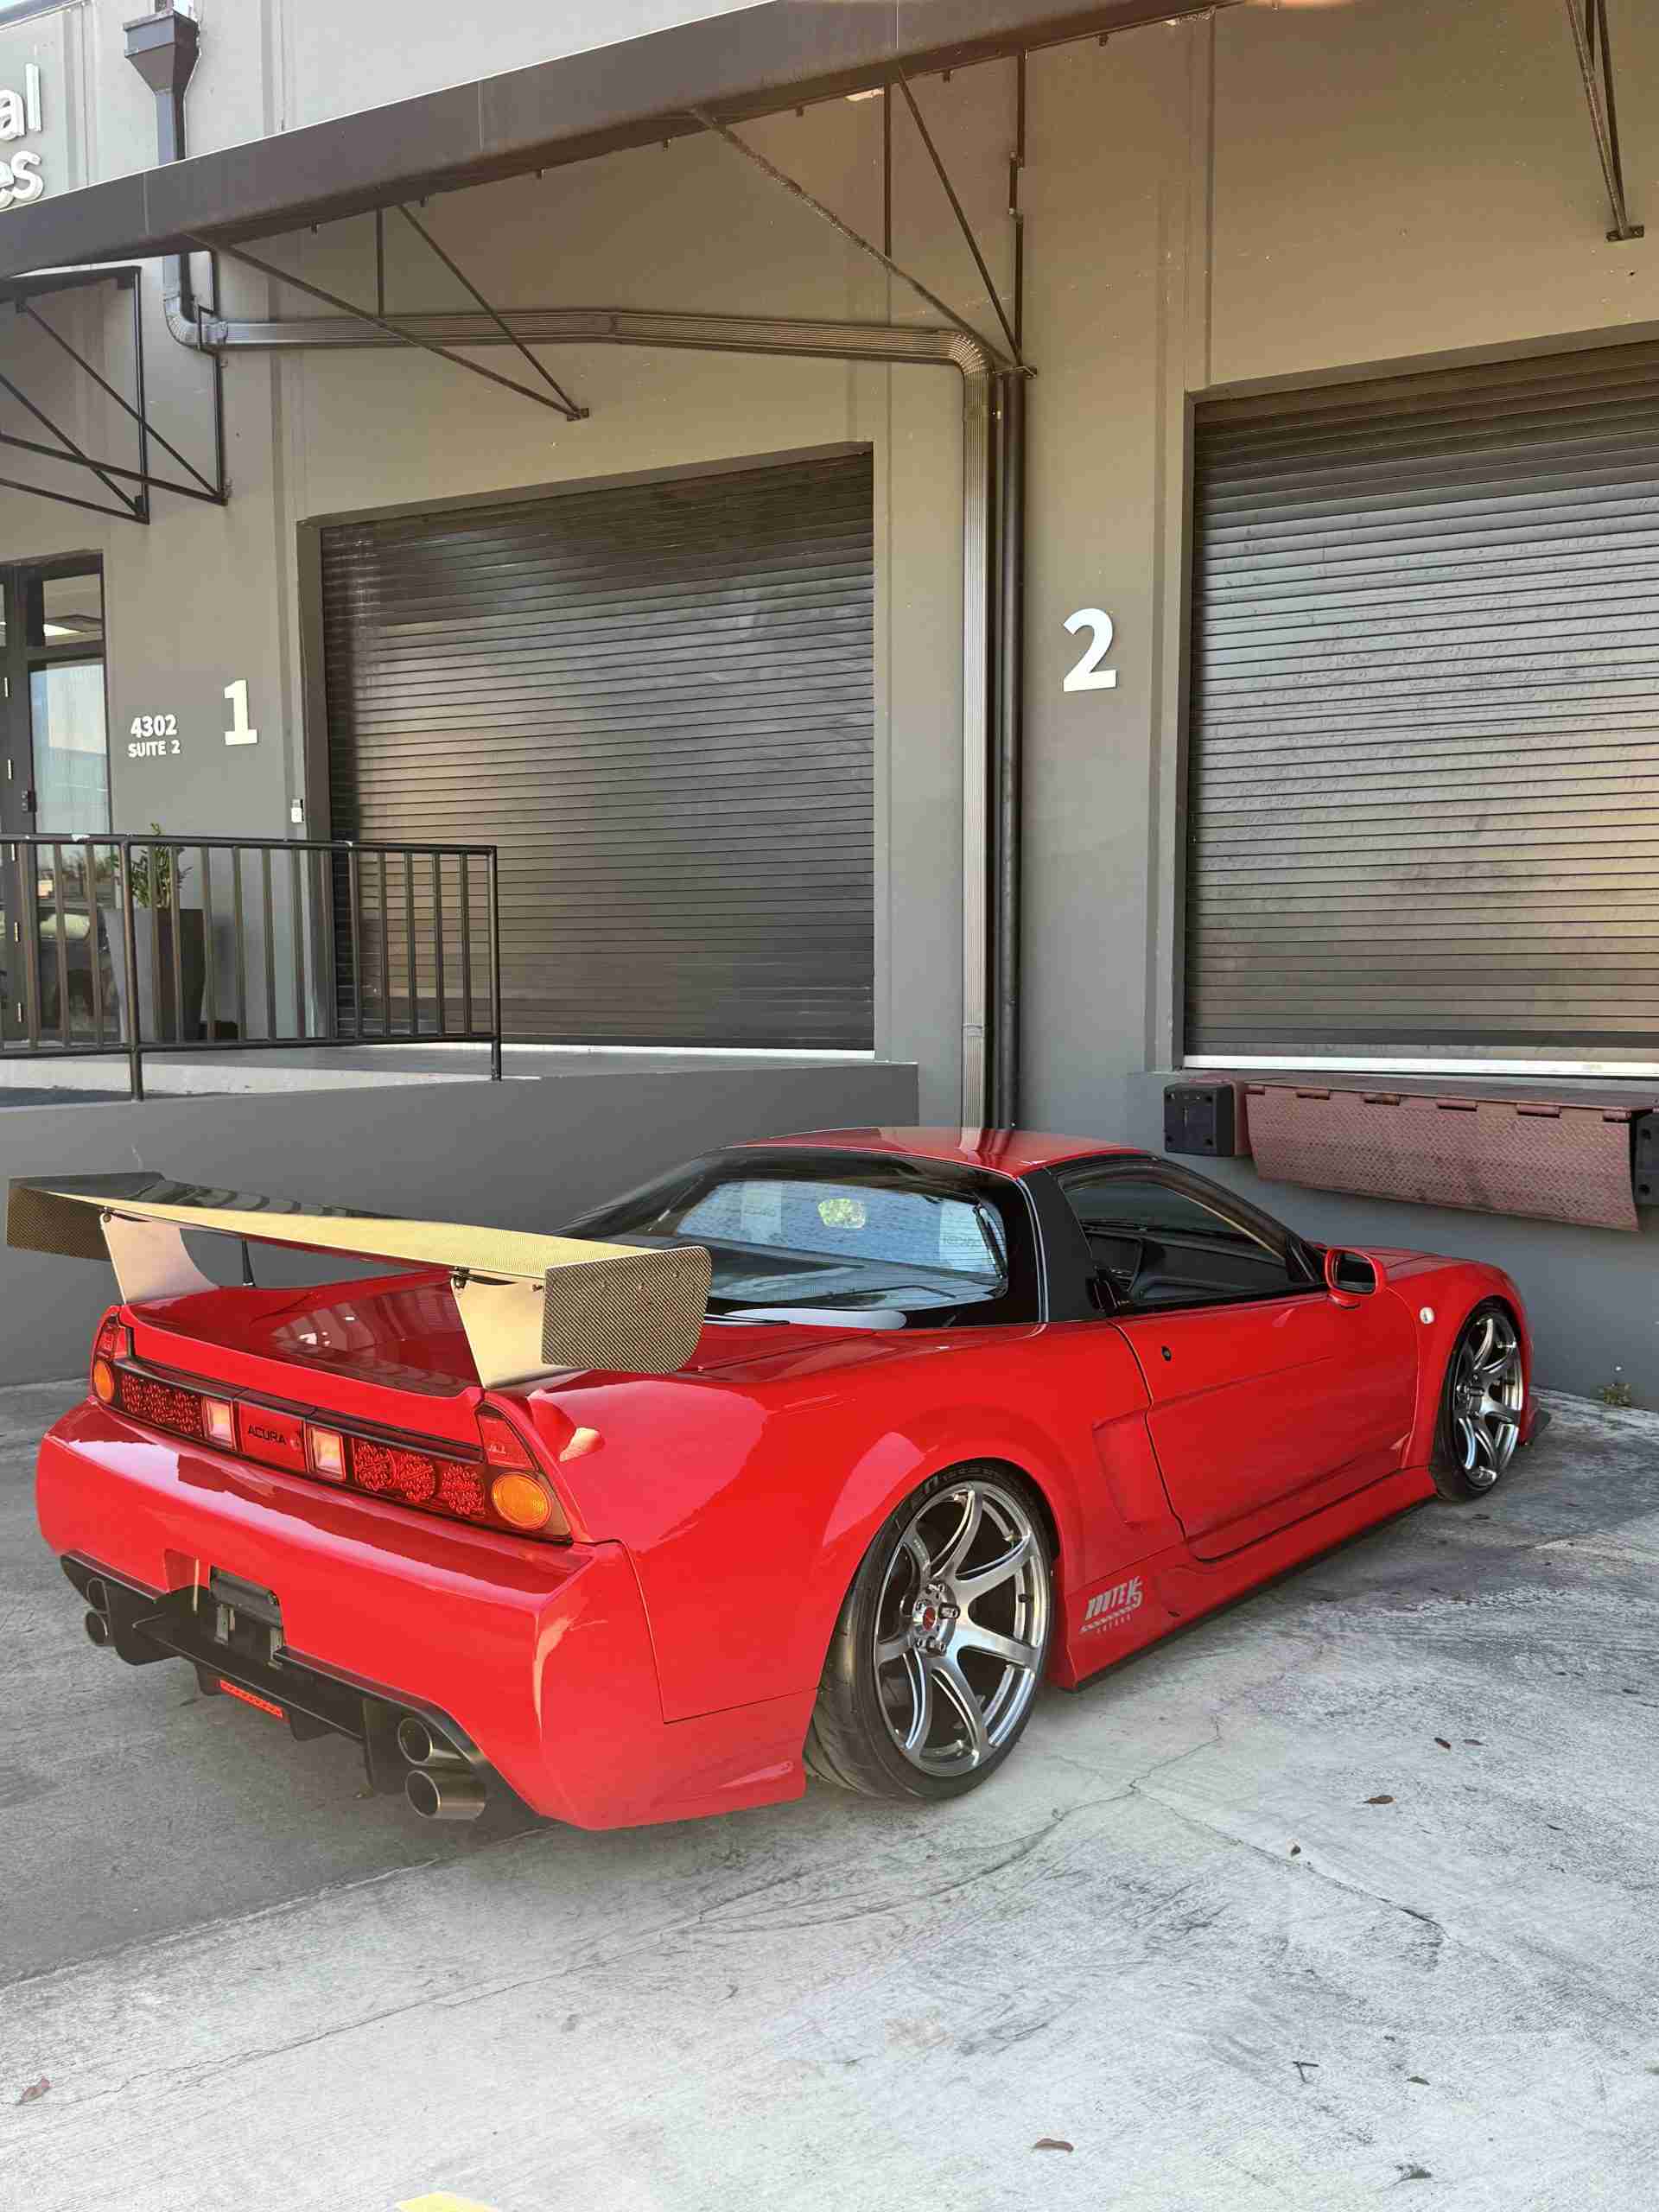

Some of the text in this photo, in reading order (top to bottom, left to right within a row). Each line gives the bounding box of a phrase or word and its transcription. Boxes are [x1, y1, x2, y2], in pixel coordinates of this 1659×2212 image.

[1063, 607, 1116, 692] 2
[224, 679, 257, 746] 1
[130, 715, 177, 738] 4302
[128, 740, 181, 758] SUITE 2
[248, 1424, 287, 1446] ACURA
